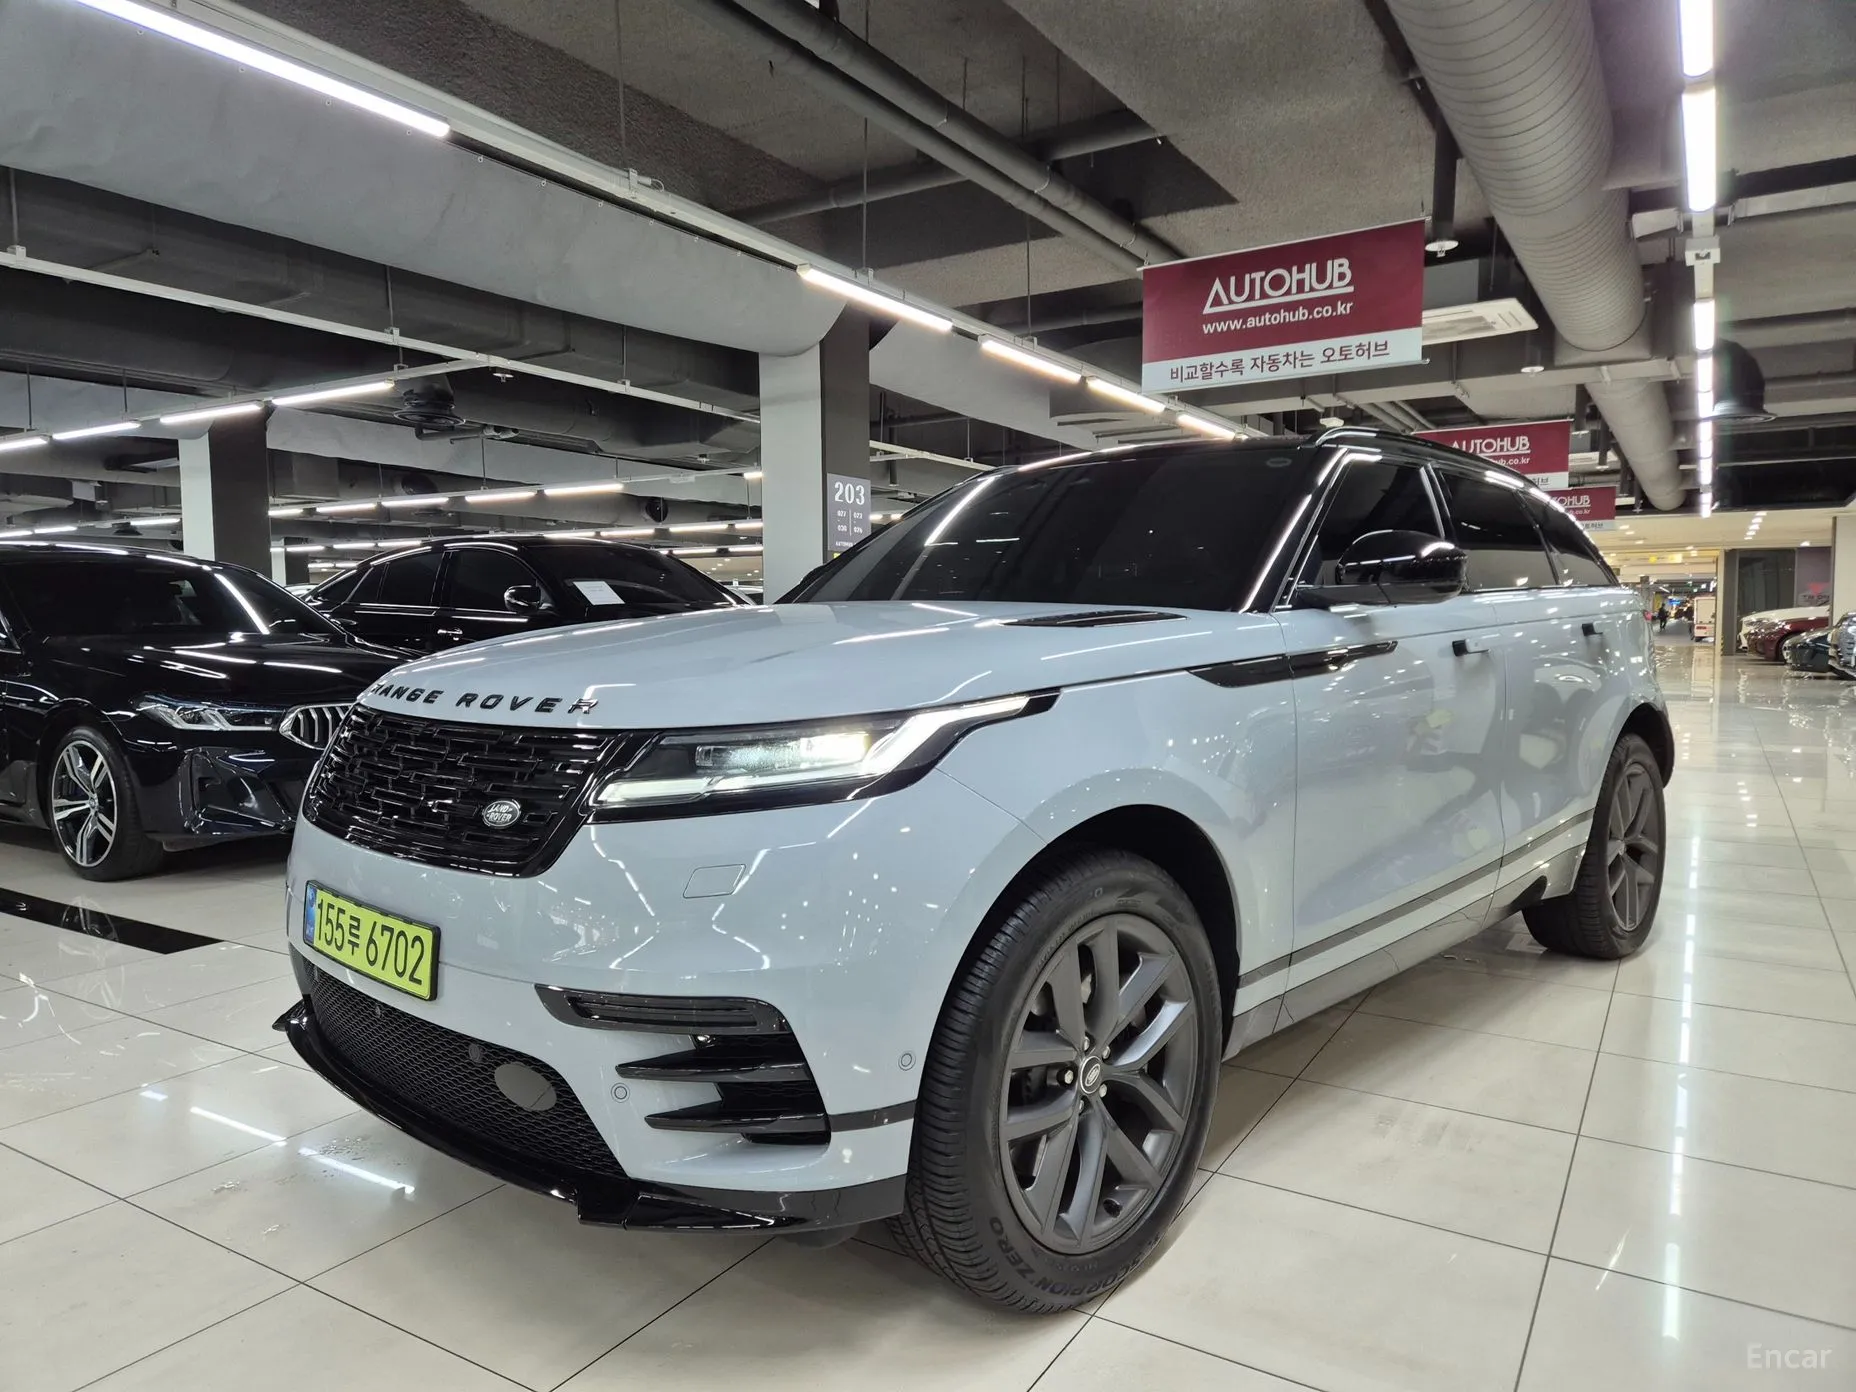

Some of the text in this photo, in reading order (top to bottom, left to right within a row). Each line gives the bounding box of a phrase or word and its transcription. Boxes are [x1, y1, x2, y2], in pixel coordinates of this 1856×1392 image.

[1203, 258, 1354, 314] AUTOHUB
[1202, 301, 1353, 334] www.autohub.co.kr
[1170, 340, 1390, 382] 비교할수록 자동차는 오토허브
[834, 481, 865, 505] 203
[456, 693, 599, 714] ROVER
[489, 812, 512, 822] ROVER
[318, 898, 425, 986] 155루 6702
